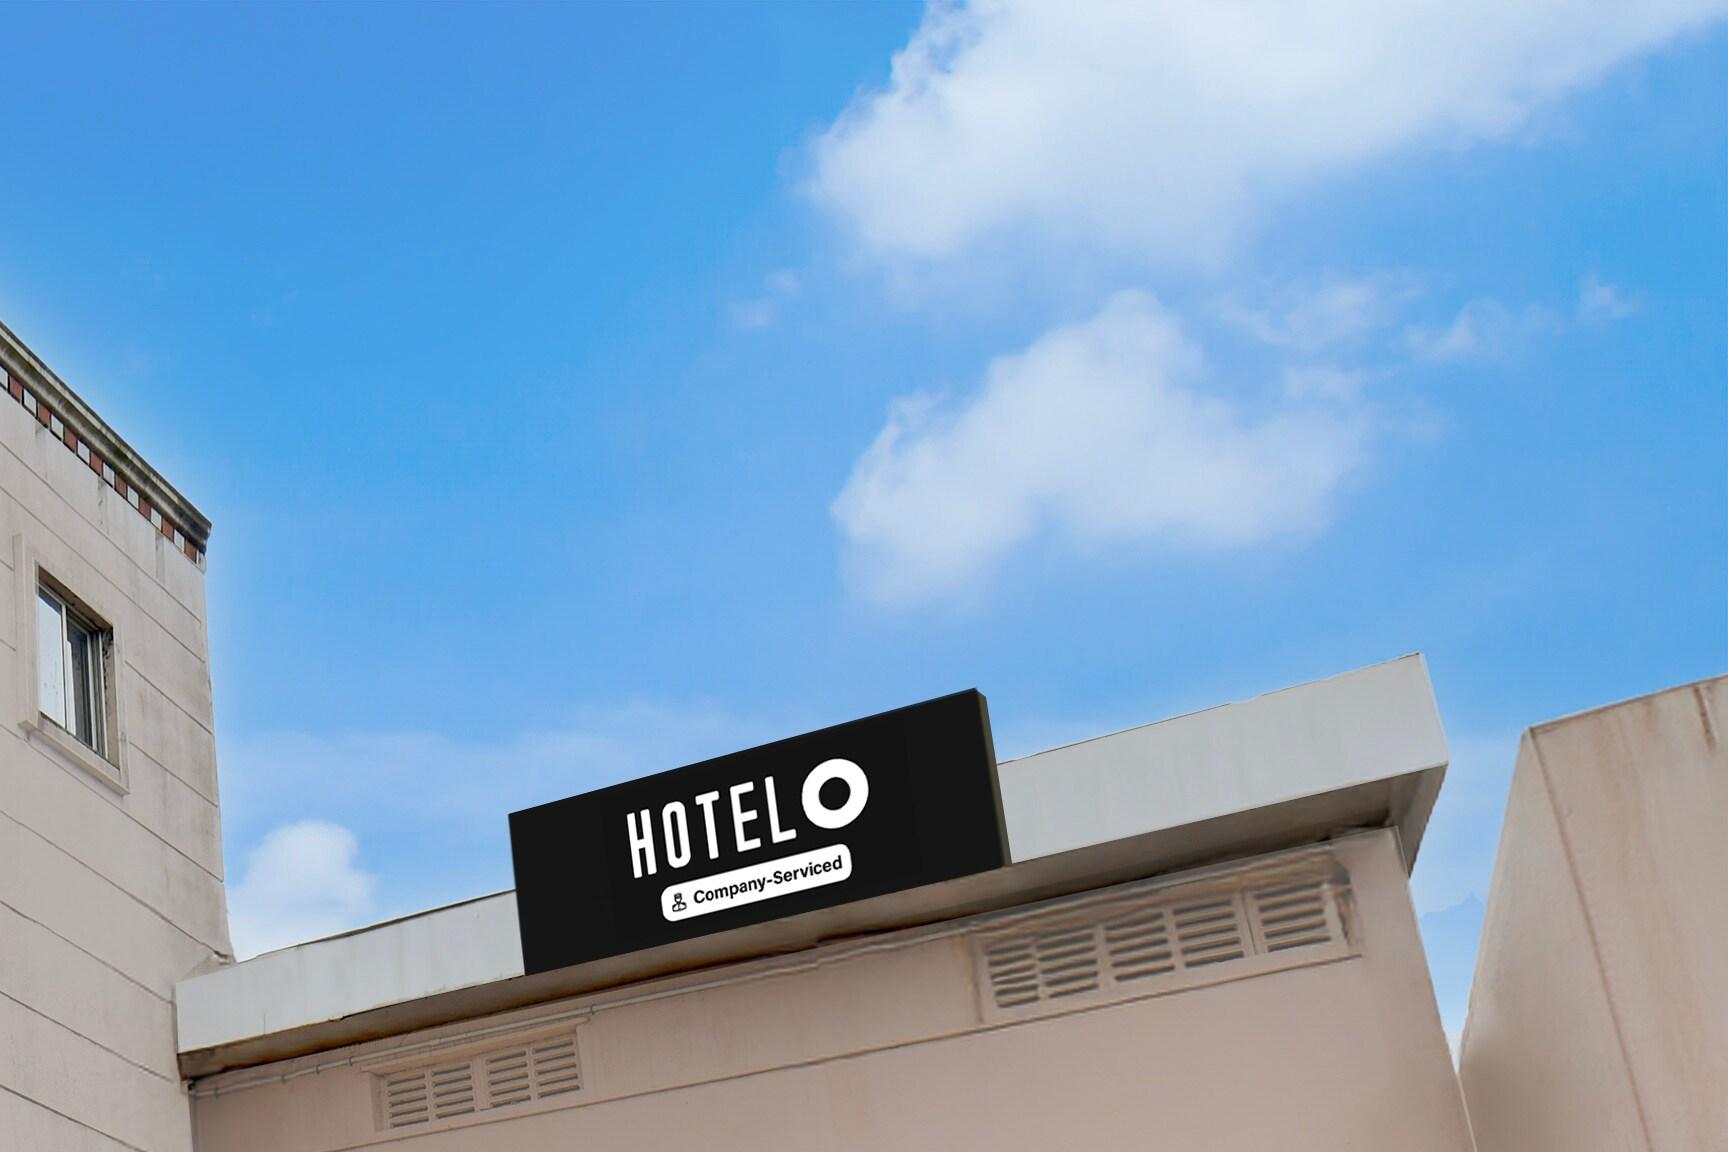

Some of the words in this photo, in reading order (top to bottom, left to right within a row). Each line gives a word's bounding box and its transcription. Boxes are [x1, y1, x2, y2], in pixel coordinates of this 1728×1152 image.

[626, 776, 797, 879] HOTEL
[801, 758, 869, 829] O
[693, 855, 843, 904] Company-Serviced
